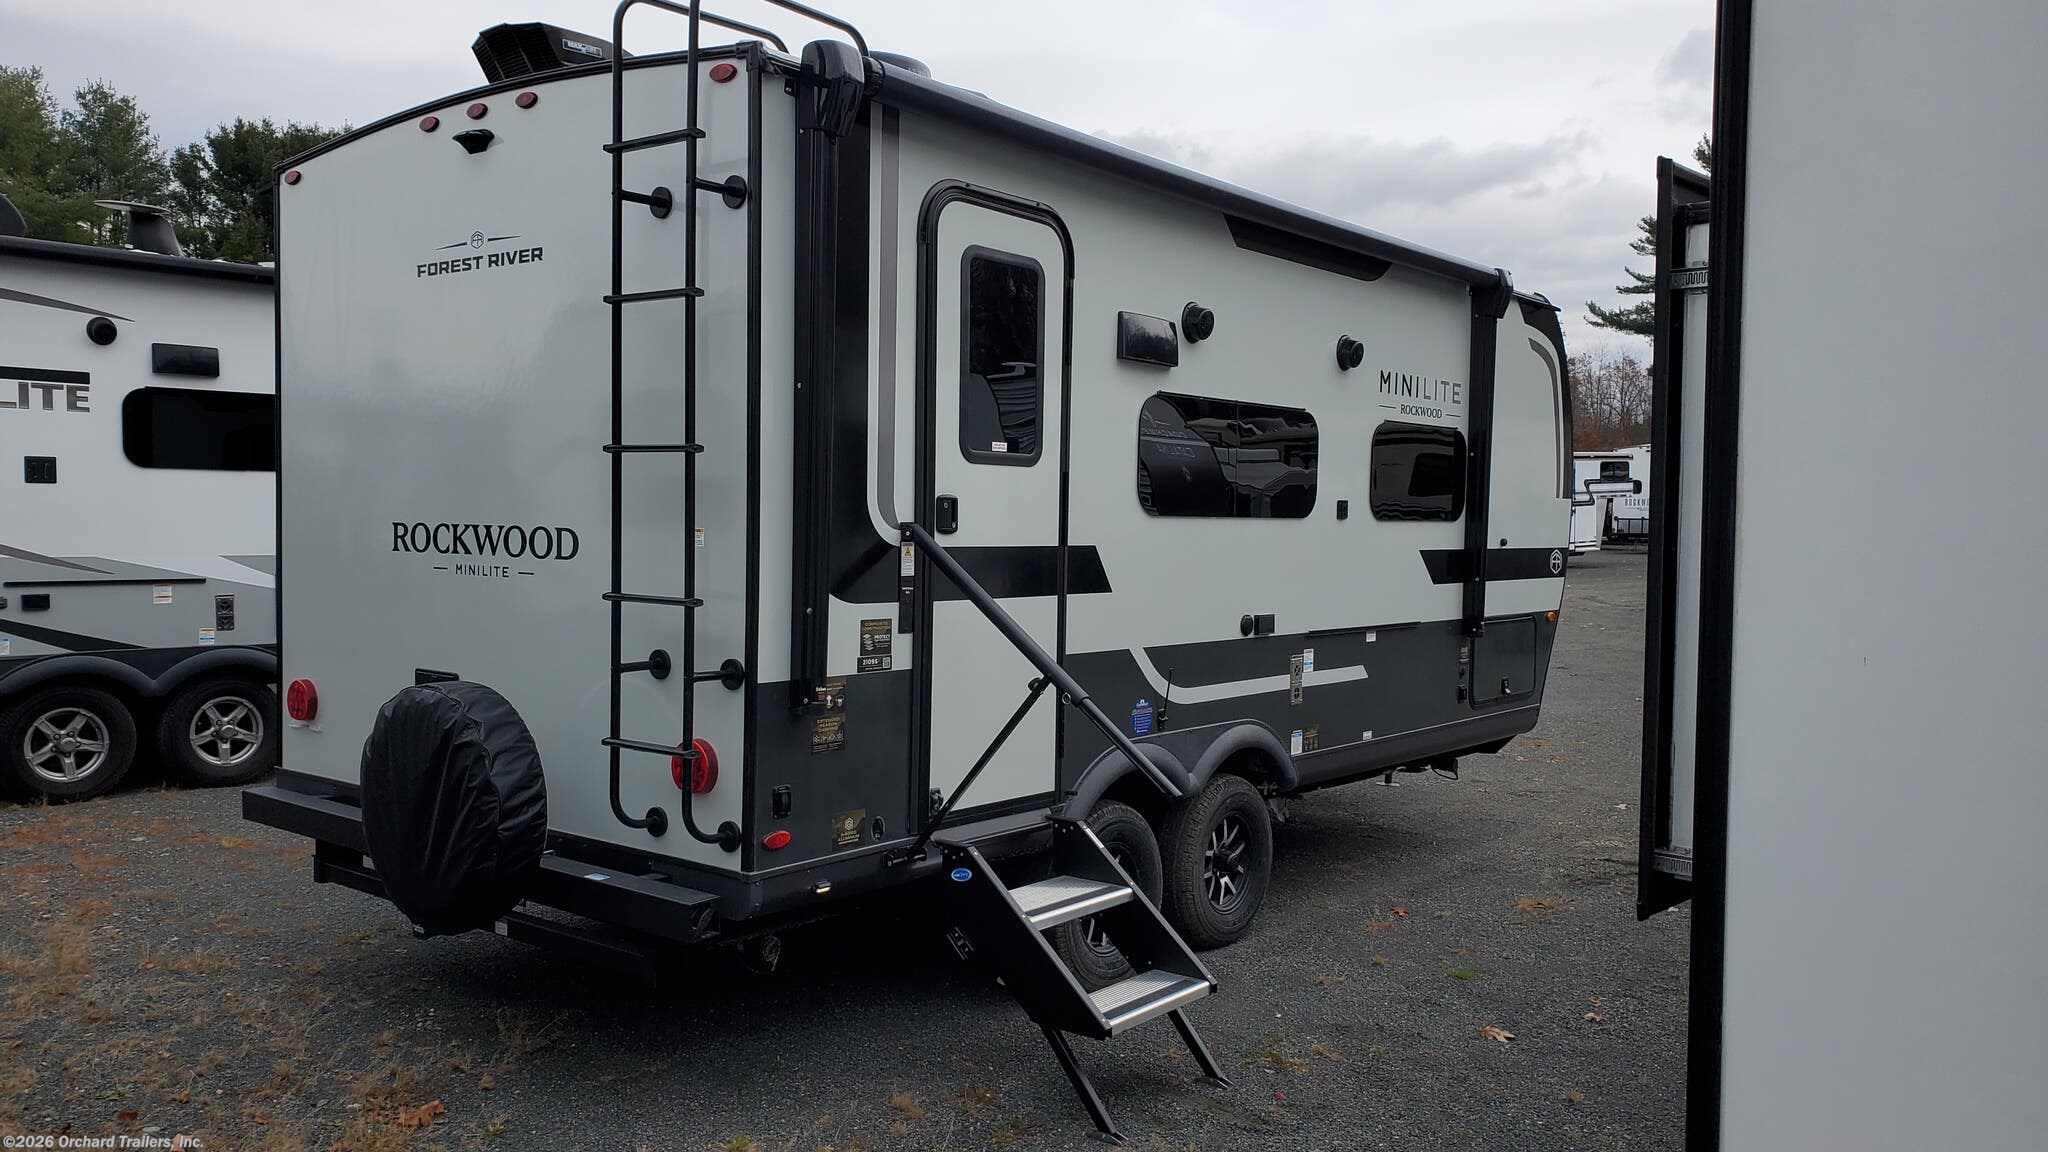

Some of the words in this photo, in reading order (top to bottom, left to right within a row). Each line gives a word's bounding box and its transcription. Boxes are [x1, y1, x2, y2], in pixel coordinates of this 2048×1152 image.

[417, 255, 484, 278] FOREST
[487, 246, 544, 268] RIVER
[1379, 369, 1462, 404] MINILITE
[1400, 404, 1443, 419] ROCKWOOD
[391, 521, 580, 562] ROCKWOOD
[455, 563, 510, 579] MINILITE
